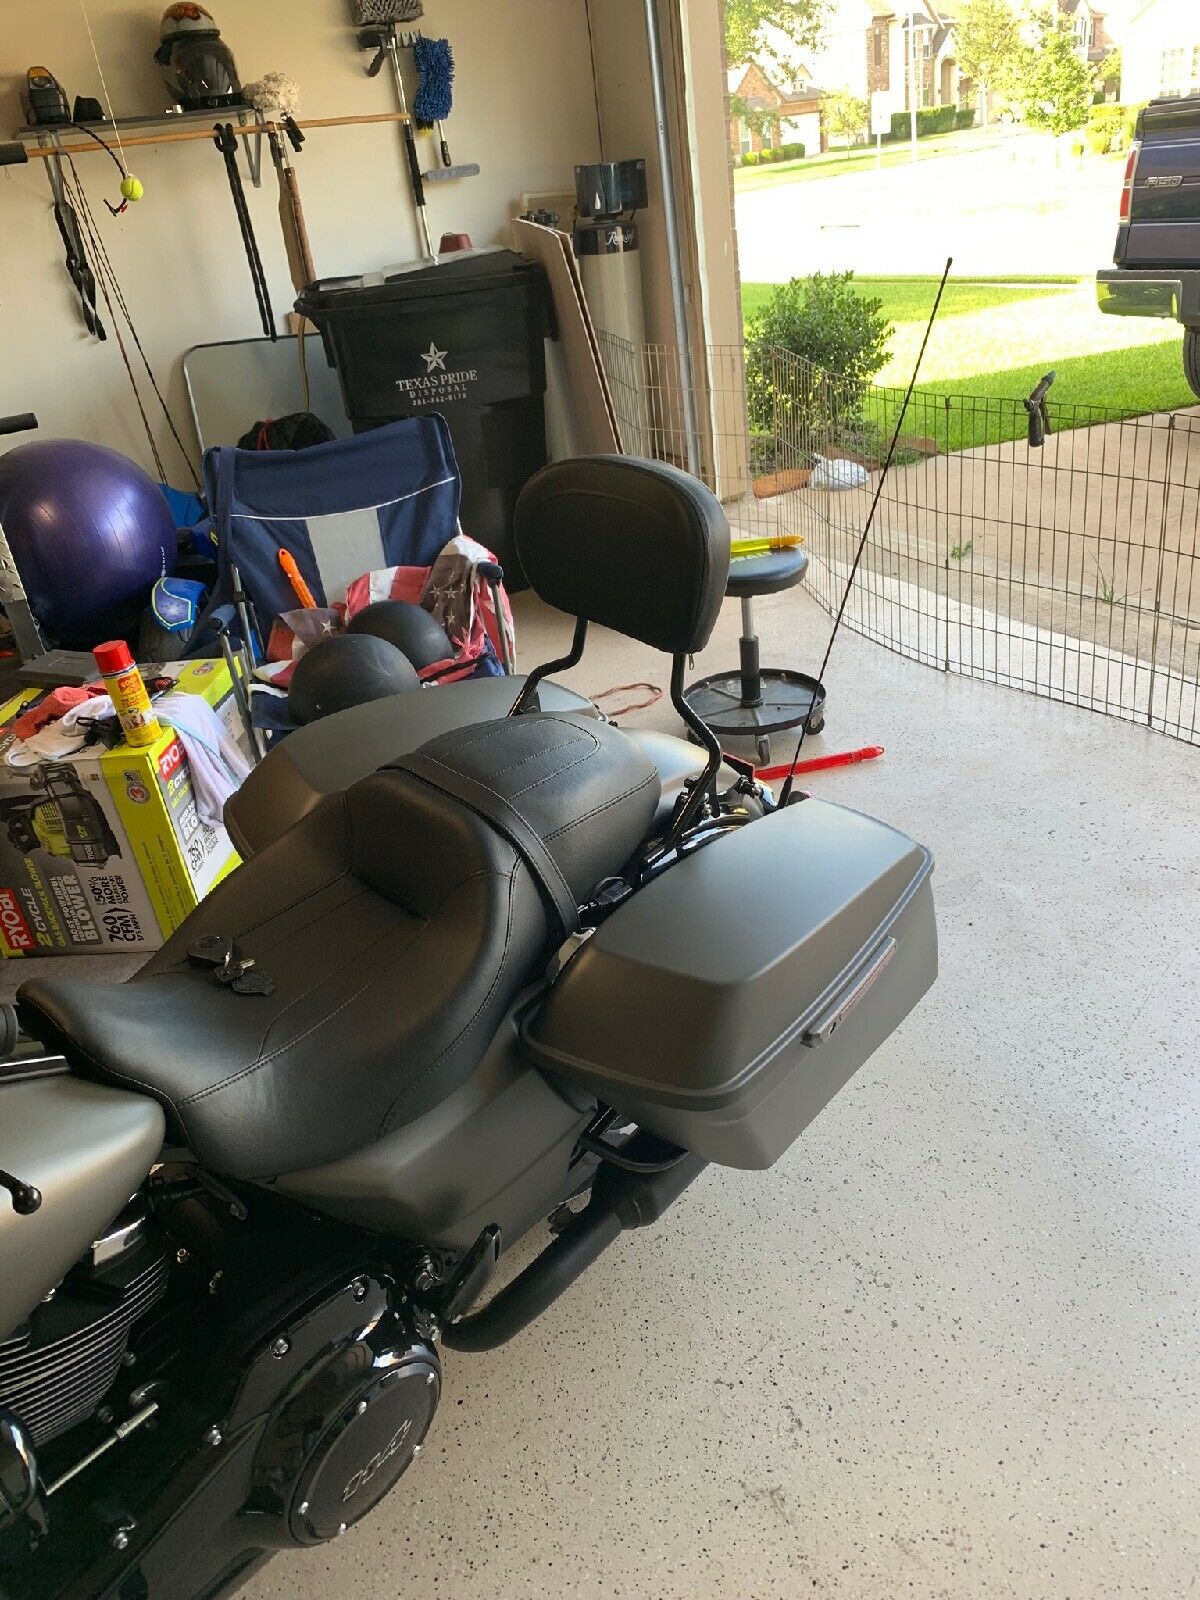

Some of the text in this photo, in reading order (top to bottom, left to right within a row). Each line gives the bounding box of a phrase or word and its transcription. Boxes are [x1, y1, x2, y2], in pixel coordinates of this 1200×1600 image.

[395, 370, 477, 391] TEXAS PRIDE
[409, 384, 467, 398] DISPOSAL
[23, 857, 43, 890] BLOWER
[98, 876, 117, 905] MORE
[114, 874, 131, 904] POWER
[0, 893, 31, 947] RYOBI
[20, 887, 54, 947] 2 CYCLE
[63, 874, 99, 940] BLOWER
[102, 915, 124, 942] 760
[116, 915, 136, 942] CFM
